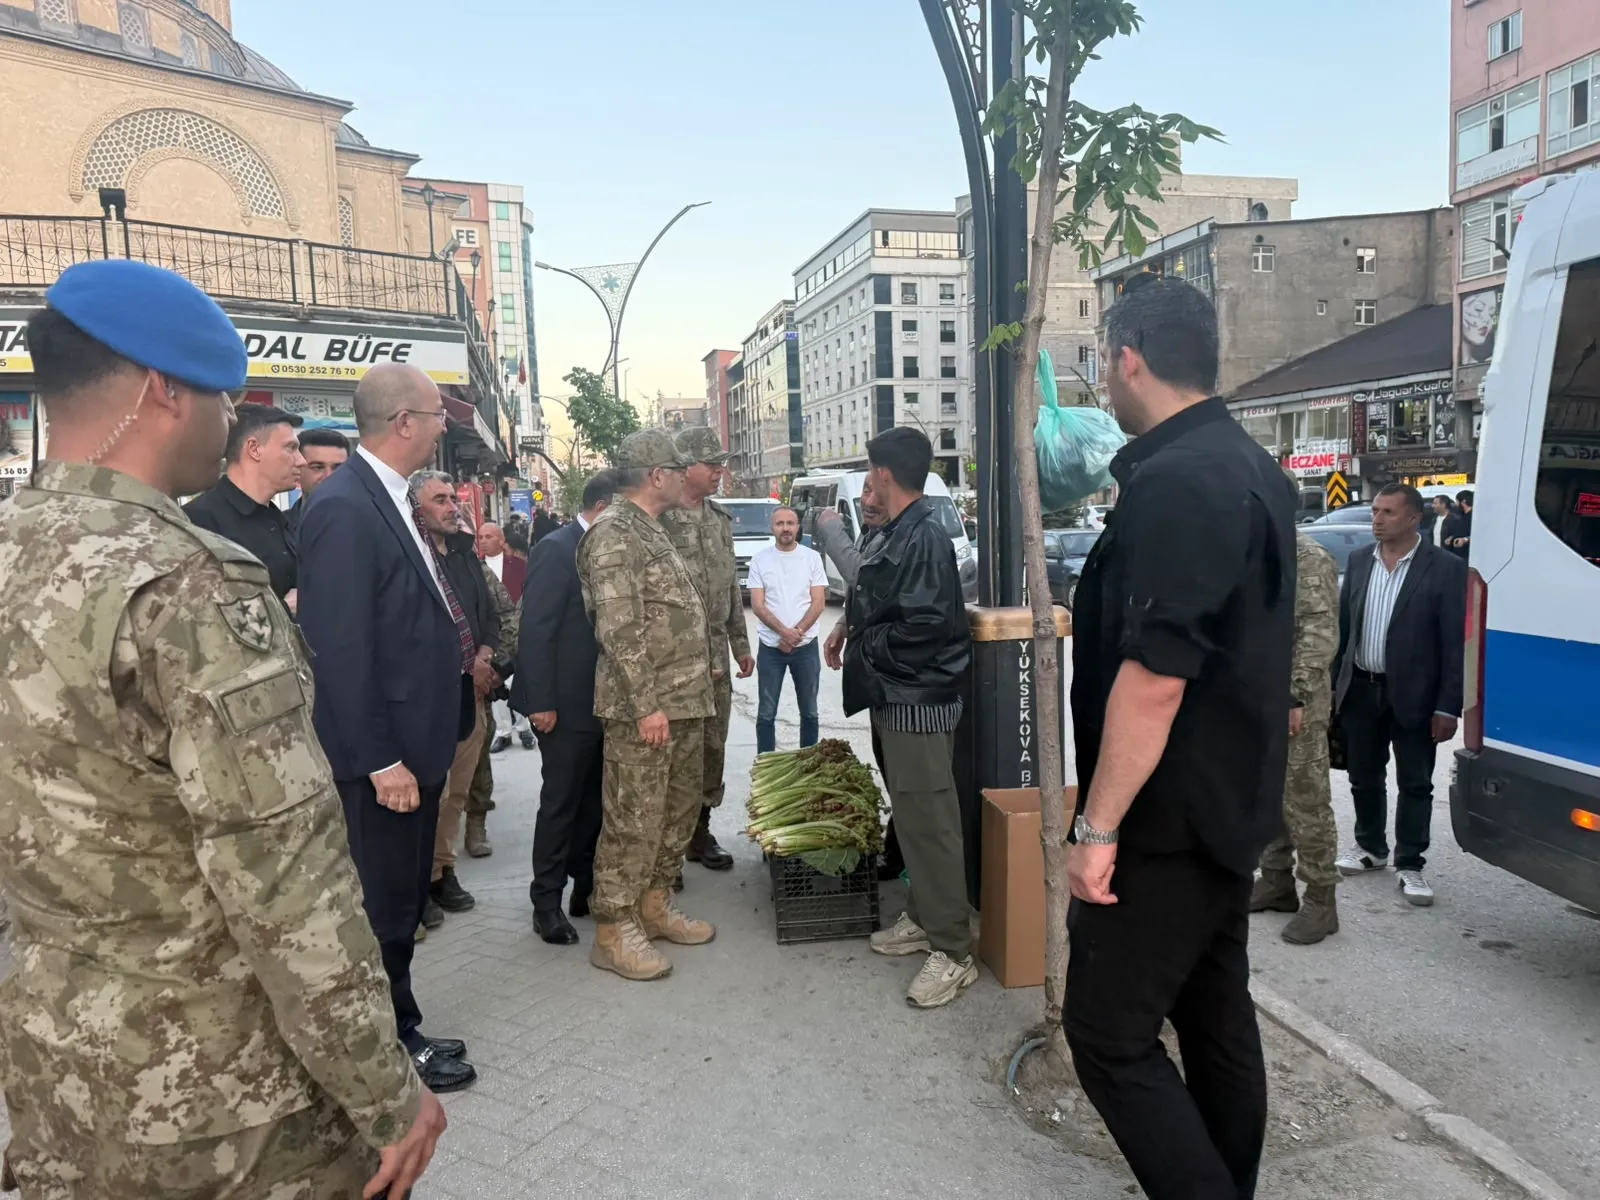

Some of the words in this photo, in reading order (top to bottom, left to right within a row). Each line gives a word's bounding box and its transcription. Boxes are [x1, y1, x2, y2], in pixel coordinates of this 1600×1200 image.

[323, 333, 412, 363] BÜFE
[282, 365, 307, 374] 0530
[309, 366, 327, 375] 252
[330, 367, 342, 375] 76
[345, 367, 356, 376] 70
[1291, 453, 1335, 469] ECZANE
[17, 467, 28, 475] 05
[1303, 468, 1323, 476] SANAT
[1018, 640, 1032, 763] YÜKSEKOVA
